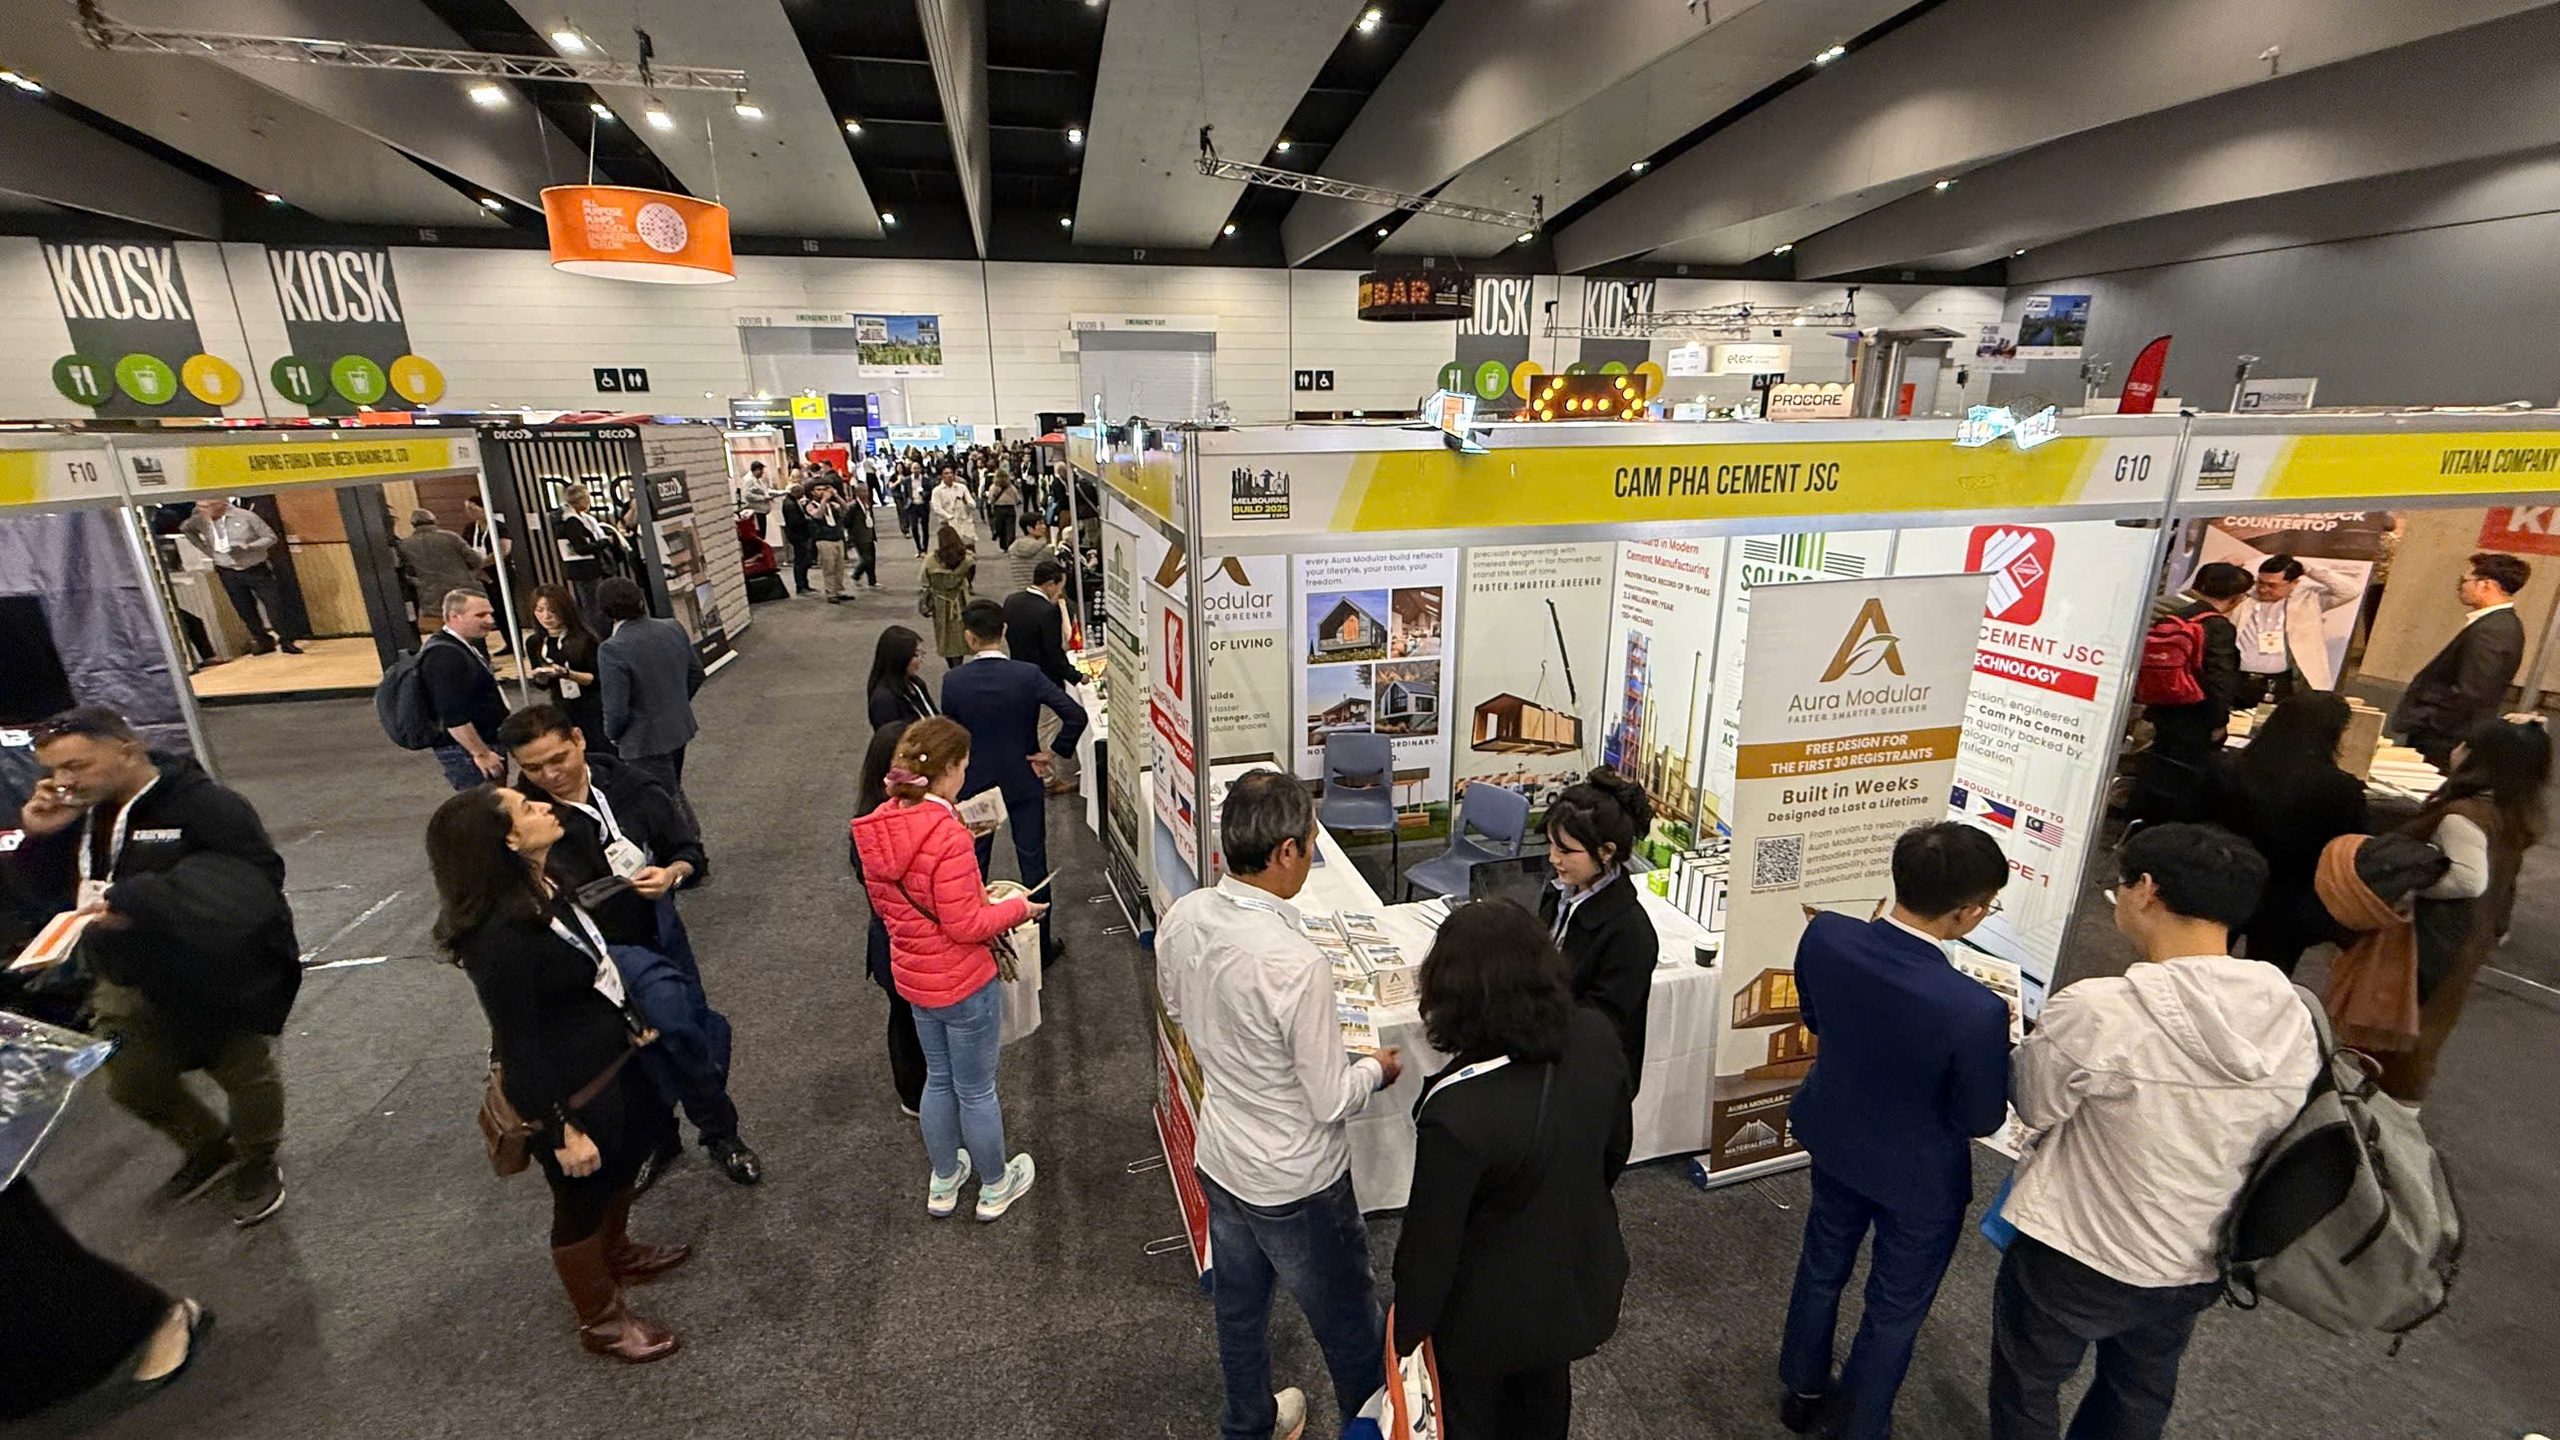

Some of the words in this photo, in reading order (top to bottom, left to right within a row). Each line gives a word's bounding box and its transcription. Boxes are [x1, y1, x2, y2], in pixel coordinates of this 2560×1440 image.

[419, 228, 438, 241] 15
[802, 240, 819, 252] 16
[1133, 249, 1147, 260] 17
[45, 243, 193, 321] KIOSK
[270, 249, 401, 322] KIOSK
[1374, 280, 1430, 305] BAR
[1458, 279, 1531, 335] IOSK
[739, 316, 762, 327] DOOR
[796, 314, 829, 322] EMERGENCY
[1076, 321, 1097, 331] DOOR
[1727, 353, 1753, 365] etex
[1772, 394, 1843, 406] PROCORE
[2262, 391, 2308, 403] OSPREY
[493, 430, 524, 440] DECO
[598, 429, 627, 439] DECO
[248, 454, 284, 471] ANPING
[333, 450, 355, 466] MESH
[2115, 455, 2151, 482] G10
[2440, 449, 2491, 475] VITANA
[2492, 448, 2560, 473] COMPANY
[67, 462, 98, 483] F10
[1614, 466, 1662, 498] CAM
[1668, 465, 1709, 496] PHA
[1716, 463, 1801, 495] CEMENT
[1804, 462, 1840, 492] JSC
[657, 482, 677, 498] DECO
[1233, 496, 1288, 505] MELBOURNE
[1233, 505, 1263, 513] BUILD
[1264, 504, 1288, 512] 2025
[2223, 516, 2339, 532] COUNTERTOP
[1473, 550, 1510, 560] precision
[1511, 547, 1558, 557] engineering
[1560, 546, 1577, 554] with
[1660, 539, 1668, 549] in
[1669, 540, 1699, 554] Modern
[1305, 557, 1328, 566] every
[1331, 556, 1351, 564] Aura
[1353, 554, 1387, 563] Modular
[1389, 553, 1410, 561] build
[1412, 551, 1443, 560] reflects
[1473, 560, 1506, 569] timeless
[1508, 559, 1535, 567] design
[1558, 556, 1584, 564] homes
[1626, 550, 1653, 564] Cement
[1654, 555, 1710, 579] Manufacturing
[1305, 568, 1324, 577] your
[1326, 566, 1361, 576] lifestyle,
[1363, 565, 1382, 574] your
[1384, 564, 1407, 572] taste,
[1409, 563, 1428, 572] your
[1473, 571, 1495, 579] stand
[1497, 569, 1510, 577] the
[1305, 577, 1343, 586] freedom.
[1625, 570, 1643, 580] PROVEN
[1643, 573, 1657, 583] TRACK
[1658, 577, 1677, 588] RECORD
[1694, 586, 1710, 596] YEARS
[1203, 591, 1273, 610] odular
[1631, 594, 1650, 605] MILLION
[1210, 640, 1228, 651] OF
[1230, 638, 1273, 650] LIVING
[1978, 625, 2058, 655] CEMENT
[2063, 644, 2105, 666] JSC
[1974, 653, 2061, 685] ECHNOLOGY
[1210, 691, 1234, 700] uilds
[1788, 693, 1840, 712] Aura
[1846, 684, 1931, 707] Modular
[1212, 712, 1251, 723] stronger,
[1253, 711, 1270, 719] and
[1214, 704, 1239, 712] faster
[1969, 689, 2007, 708] cision,
[2009, 701, 2080, 727] engineered
[1209, 723, 1235, 732] odular
[1238, 723, 1267, 733] spaces
[1979, 705, 2006, 721] Cam
[2008, 713, 2032, 728] Pha
[2034, 721, 2086, 744] Cement
[1805, 742, 1835, 756] FREE
[1836, 736, 1880, 752] DESIGN
[1882, 734, 1908, 747] FOR
[1963, 728, 1994, 745] ology
[1996, 738, 2020, 753] and
[1976, 718, 2016, 739] quality
[2018, 731, 2064, 753] backed
[2066, 745, 2083, 760] by
[1770, 762, 1796, 775] THE
[1798, 757, 1832, 772] FIRST
[1833, 756, 1848, 768] 30
[1850, 747, 1934, 766] REGISTRANTS
[1960, 740, 2016, 767] rtification.
[1782, 786, 1829, 805] Built
[1833, 783, 1849, 799] in
[1855, 776, 1919, 795] Weeks
[1767, 805, 1826, 823] Designed
[1828, 804, 1840, 815] to
[1842, 799, 1867, 813] Last
[1868, 801, 1877, 809] a
[1879, 795, 1929, 809] Lifetime
[1957, 777, 2003, 799] PROUDLY
[2005, 795, 2048, 817] EXPORT
[2049, 811, 2065, 824] TO
[1809, 829, 1833, 839] From
[1835, 825, 1861, 836] vision
[1863, 822, 1874, 831] to
[1875, 819, 1907, 831] reality,
[1808, 842, 1830, 851] Aura
[1832, 836, 1869, 848] Modular
[1871, 832, 1896, 843] build
[1805, 860, 1868, 876] sustainability,
[1870, 856, 1890, 866] and
[1806, 851, 1851, 864] embodies
[1803, 871, 1862, 888] architectural
[1864, 868, 1891, 879] desig
[2007, 858, 2035, 882] PE
[2040, 874, 2051, 888] 1
[1727, 1104, 1749, 1113] AURA
[1749, 1095, 1784, 1108] MODULAR
[1724, 1137, 1779, 1154] MATERIALEDGE
